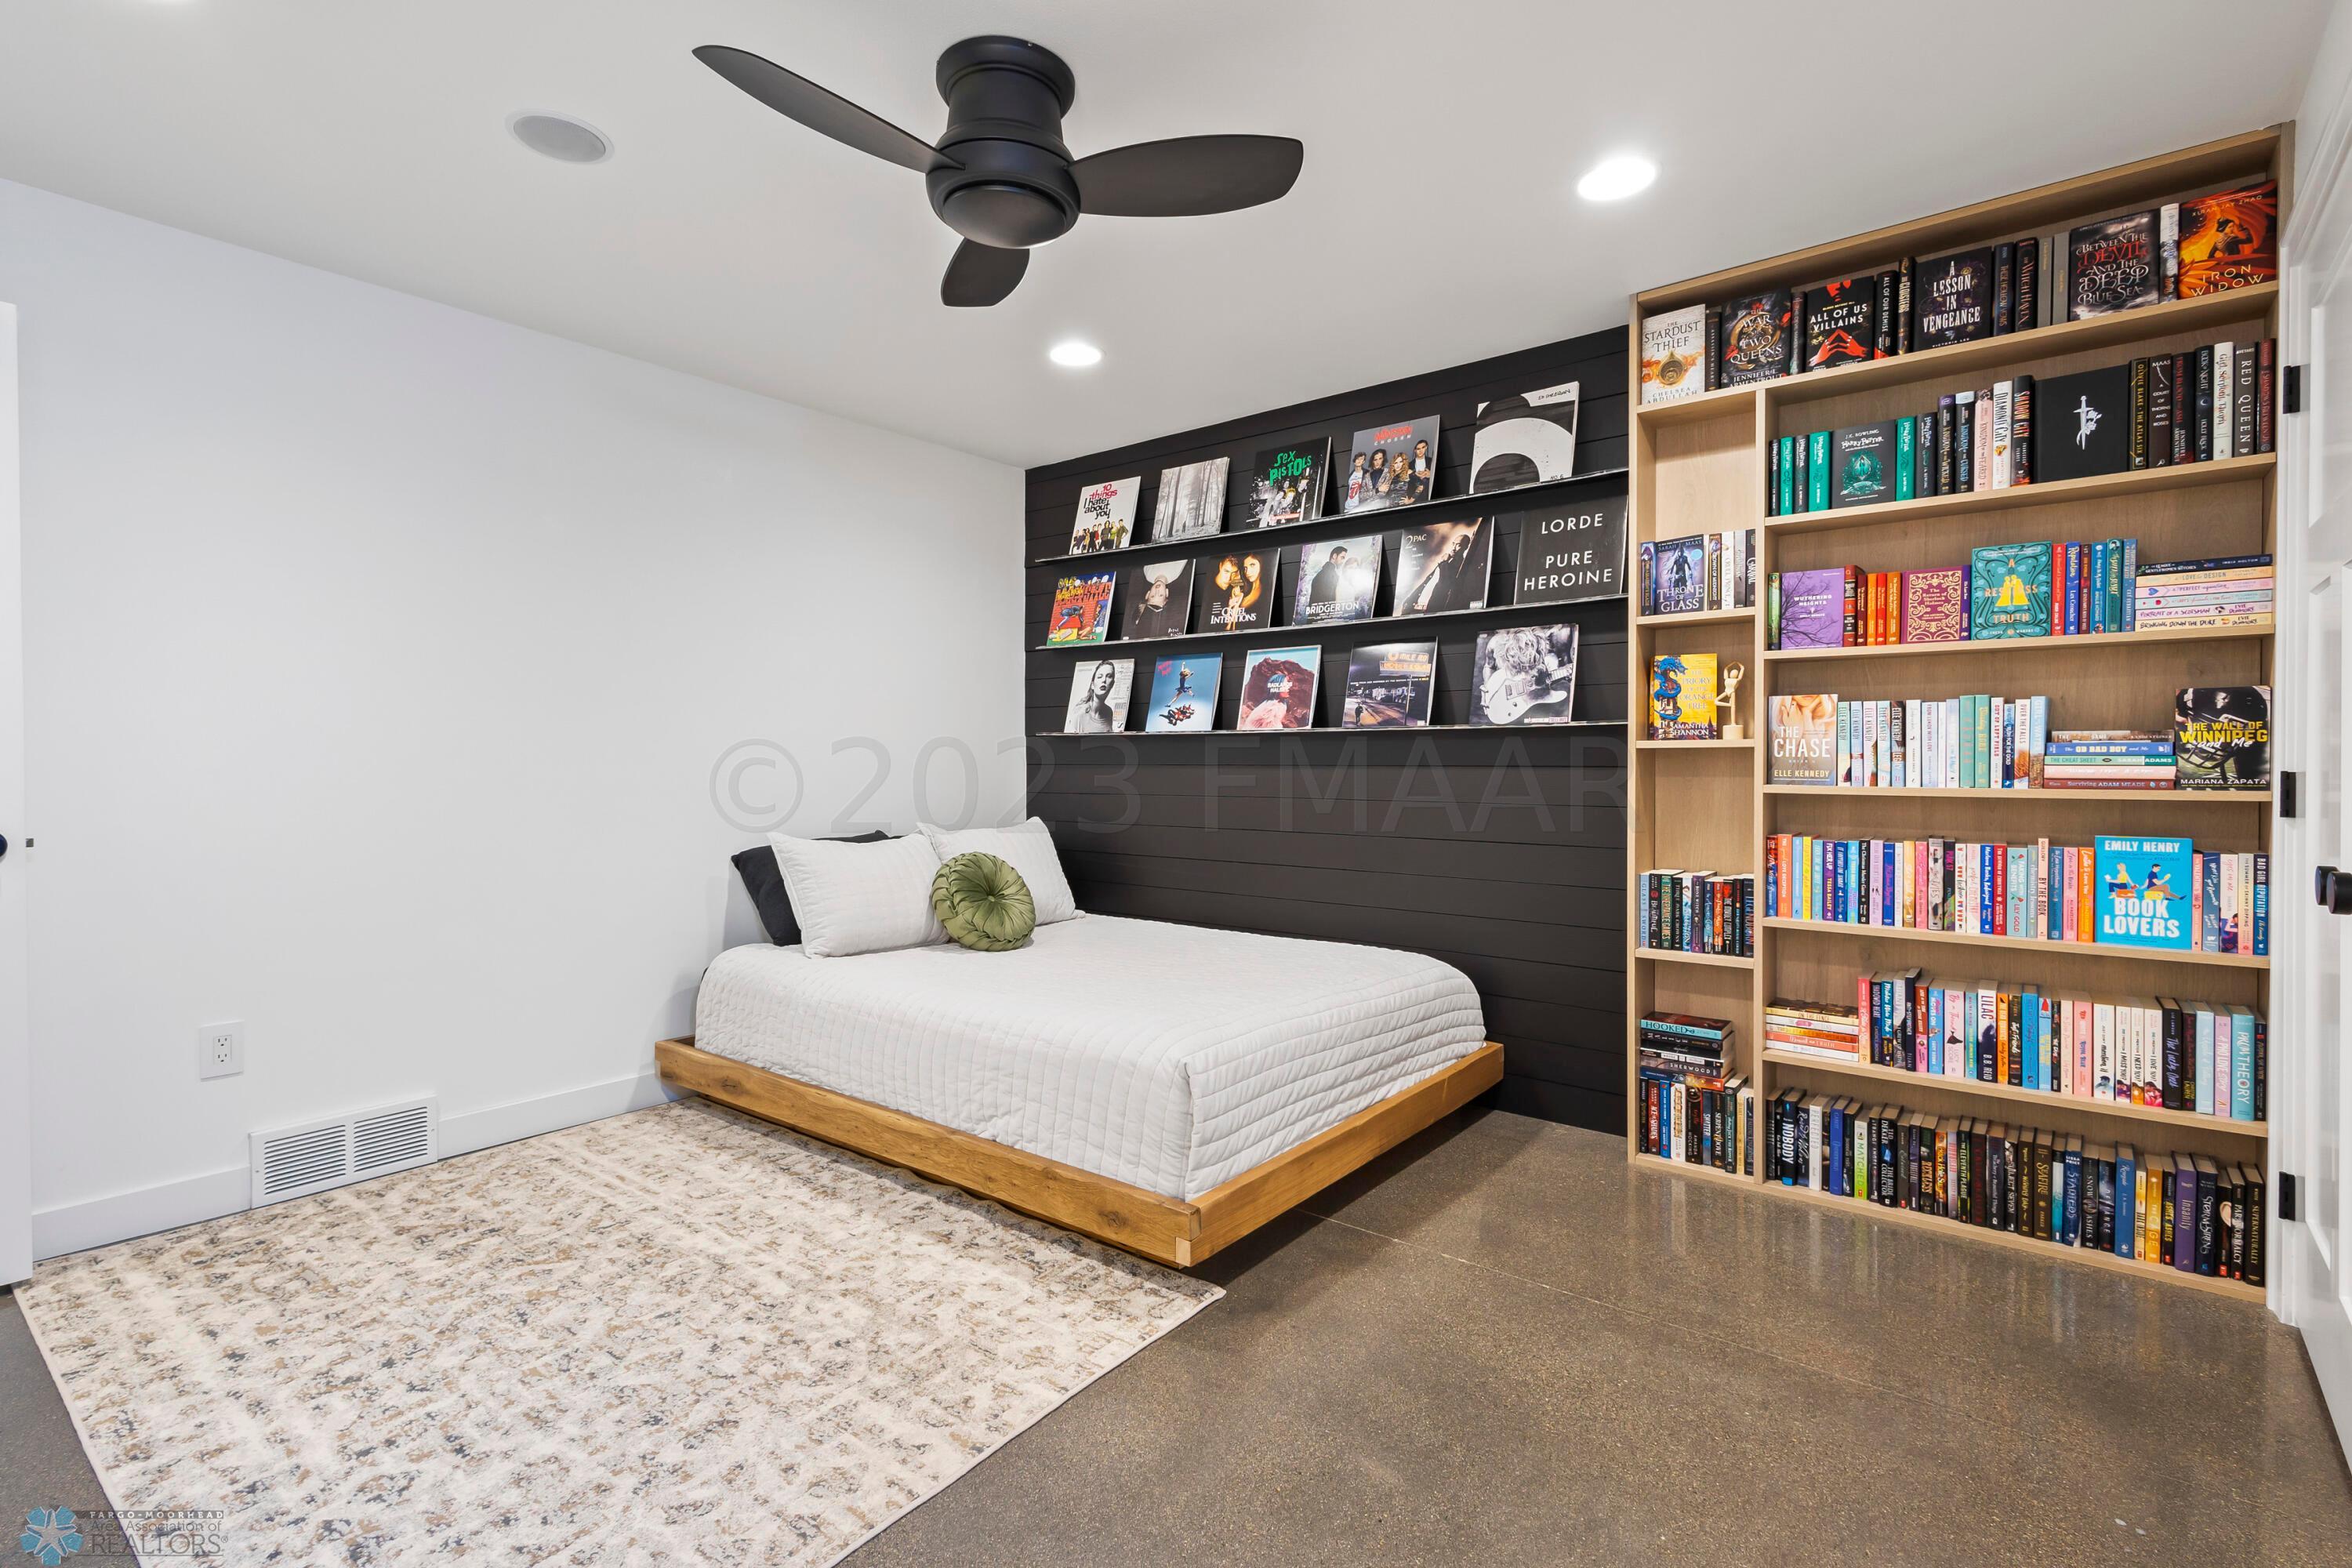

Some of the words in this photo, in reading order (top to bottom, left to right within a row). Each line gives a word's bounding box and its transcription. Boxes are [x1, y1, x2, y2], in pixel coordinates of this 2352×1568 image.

[2238, 195, 2263, 205] ZHAO
[2078, 241, 2148, 267] DEVIL
[1950, 260, 1955, 276] A
[2085, 263, 2116, 275] AND
[2119, 259, 2139, 268] THE
[2202, 263, 2251, 283] IRON
[1933, 274, 1971, 296] LESSON
[2078, 265, 2149, 292] DEEP
[2191, 273, 2263, 297] WIDOW
[1947, 294, 1957, 310] IN
[2078, 289, 2112, 306] BLUE
[2112, 285, 2143, 301] SEA
[1742, 314, 1772, 328] WAR
[1810, 310, 1831, 323] ALL
[1833, 307, 1849, 318] OF
[1853, 304, 1867, 313] US
[1923, 307, 1980, 333] VENGEANCE
[1813, 314, 1864, 332] VILLAINS
[1643, 320, 1701, 343] STARDUST
[1653, 336, 1690, 353] THIEF
[1740, 335, 1772, 350] TWO
[1730, 345, 1782, 365] QUEENS
[2200, 369, 2209, 389] NIGHT
[2241, 360, 2252, 385] RED
[1652, 387, 1691, 397] CHELSEA
[1994, 392, 2009, 426] DIAMOND
[2013, 391, 2030, 420] SHADOW
[2238, 394, 2251, 442] QUEEN
[1958, 424, 1969, 451] KINGDOM
[1994, 427, 2008, 442] CITY
[2013, 422, 2030, 438] CITY
[1374, 434, 1411, 445] CHOSEN
[1940, 426, 1951, 452] KINGDOM
[1960, 459, 1969, 481] CURSED
[1089, 488, 1118, 502] things
[1102, 483, 1112, 492] 10
[1083, 498, 1087, 509] I
[1088, 497, 1108, 509] hate
[1083, 503, 1110, 515] about
[1095, 510, 1111, 520] you
[1541, 513, 1603, 535] LORDE
[1545, 550, 1592, 569] PURE
[1524, 568, 1612, 591] HEROINE
[1657, 583, 1704, 603] THRONE
[1305, 601, 1359, 615] BRIDGERTON
[1661, 598, 1700, 612] GLASS
[1210, 613, 1256, 624] INTENTIONS
[1994, 613, 2029, 623] TRUTH
[1682, 677, 1711, 685] PRIORY
[1679, 692, 1715, 702] ORANGE
[1688, 701, 1707, 710] TREE
[1780, 727, 1799, 738] THE
[2185, 722, 2209, 731] THE
[2211, 721, 2244, 731] WALL
[2249, 720, 2263, 729] OF
[2180, 729, 2268, 743] WINNIPEG
[2198, 738, 2221, 747] and
[2231, 738, 2253, 747] Me
[1773, 739, 1831, 757] CHASE
[2104, 840, 2139, 851] EMILY
[2143, 842, 2180, 853] HENRY
[2257, 858, 2266, 869] BAD
[2257, 870, 2266, 883] GIRL
[2114, 898, 2169, 918] BOOK
[2256, 884, 2267, 917] REPUTATION
[2103, 916, 2180, 938] LOVERS
[1981, 996, 1994, 1020] LILAC
[1646, 1022, 1687, 1033] HOOKED
[1931, 1017, 1936, 1025] ON
[2218, 1043, 2227, 1055] PHO
[2238, 1032, 2250, 1054] PROM
[1983, 1054, 1992, 1065] B.B.
[2218, 1057, 2227, 1072] LOVE
[1670, 1063, 1710, 1073] SHERWOOD
[1983, 1067, 1992, 1080] REID
[2238, 1056, 2250, 1104] THEORY
[1782, 1123, 1794, 1163] NOBODY
[1922, 1160, 1933, 1193] RECKLESS
[2037, 1163, 2049, 1195] SEAFIRE
[2180, 1200, 2193, 1230] Insanity
